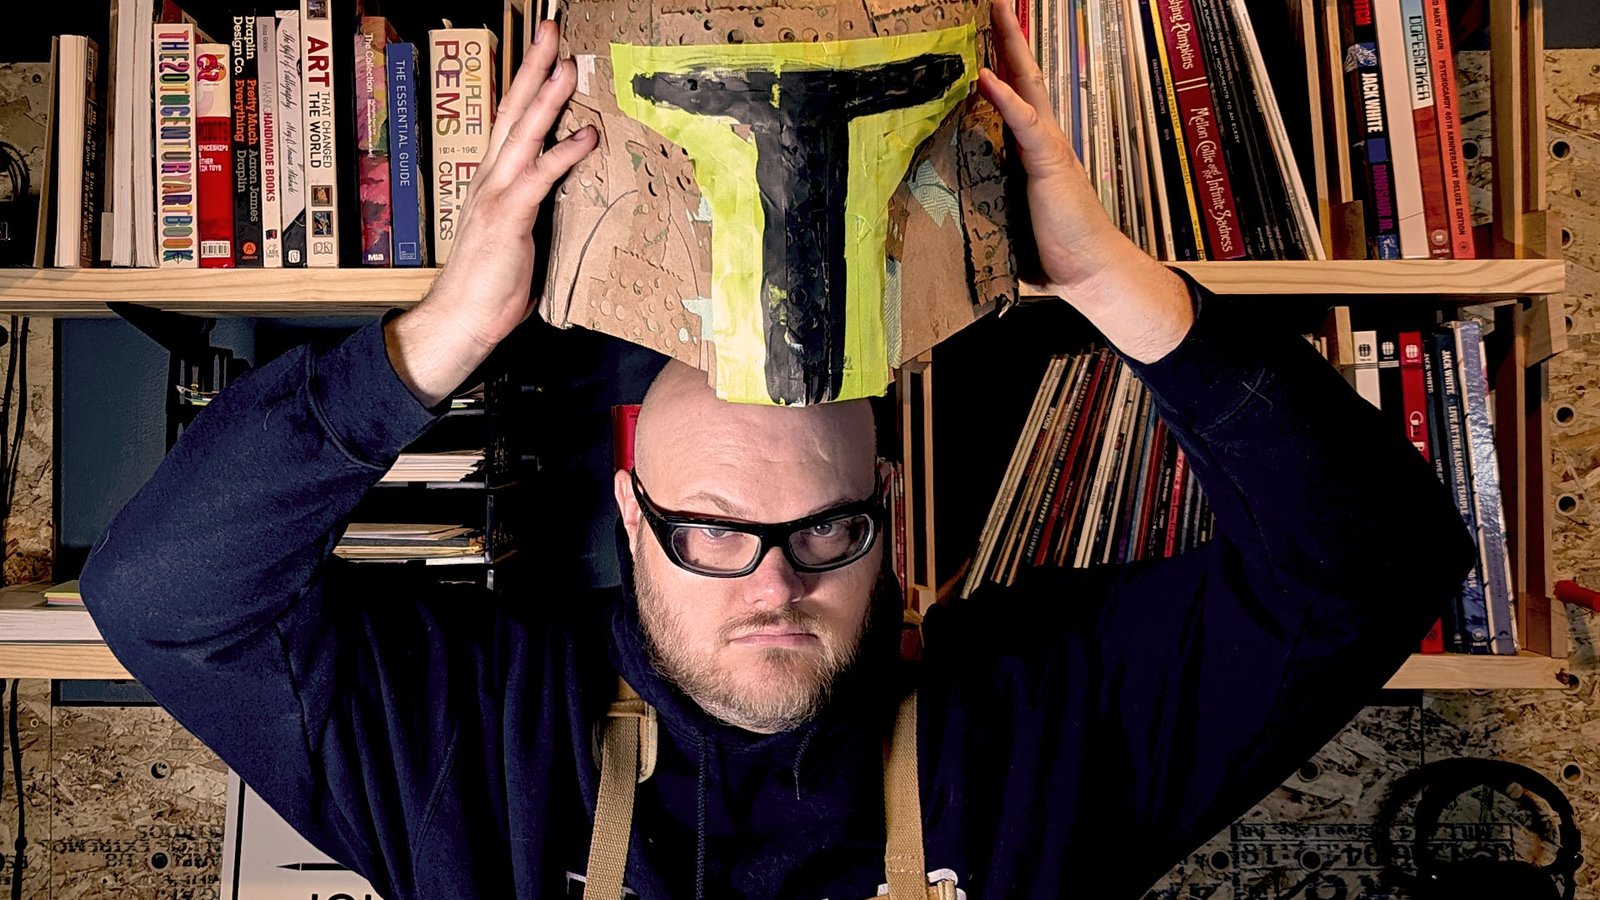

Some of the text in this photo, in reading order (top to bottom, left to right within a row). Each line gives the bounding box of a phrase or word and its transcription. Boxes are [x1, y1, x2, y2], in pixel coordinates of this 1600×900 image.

[243, 16, 256, 60] Draplin
[282, 29, 296, 44] The
[1432, 7, 1442, 29] MARY
[231, 16, 244, 75] Design Co.
[280, 45, 296, 60] Gift
[1170, 22, 1194, 70] Pumpkins
[1409, 15, 1431, 101] DOPESMOKER
[1435, 29, 1445, 50] CHAIN
[307, 36, 330, 87] ART
[365, 33, 375, 93] The Collection
[1216, 57, 1229, 99] MONUMENTS
[280, 70, 297, 110] Calligraphy
[435, 40, 464, 137] POEMS
[464, 41, 482, 135] COMPLETE
[1225, 101, 1232, 110] TO
[1361, 73, 1384, 133] JACK WHITE
[1438, 60, 1451, 109] PSYCHOCANDY
[234, 79, 246, 142] Everything
[245, 79, 258, 145] Pretty Much
[309, 92, 322, 168] THE WORLD
[321, 92, 332, 168] THAT CHANGED
[396, 60, 410, 187] THE ESSENTIAL GUIDE
[1188, 107, 1210, 139] Mellon
[1228, 112, 1235, 121] AN
[1195, 140, 1217, 163] Collie
[1230, 122, 1240, 144] ELEGY
[236, 150, 248, 192] Draplin
[1208, 163, 1222, 175] and
[1446, 131, 1459, 178] ANNIVERSARY
[248, 149, 260, 222] Aaron James
[265, 169, 276, 202] BOOKS
[438, 161, 453, 241] CUMMINGS
[1206, 177, 1226, 210] Infinite
[1372, 164, 1393, 217] DINOSAUR
[1452, 180, 1463, 206] DELUXE
[1208, 209, 1233, 252] Sadness
[1456, 208, 1466, 235] EDITION
[313, 242, 332, 255] DK
[1423, 353, 1432, 370] JACK
[1426, 371, 1434, 393] WHITE
[1042, 406, 1056, 430] SPOON
[1441, 350, 1469, 516] JACK WHITE LIVE AT THE MASONIC TEMPLE
